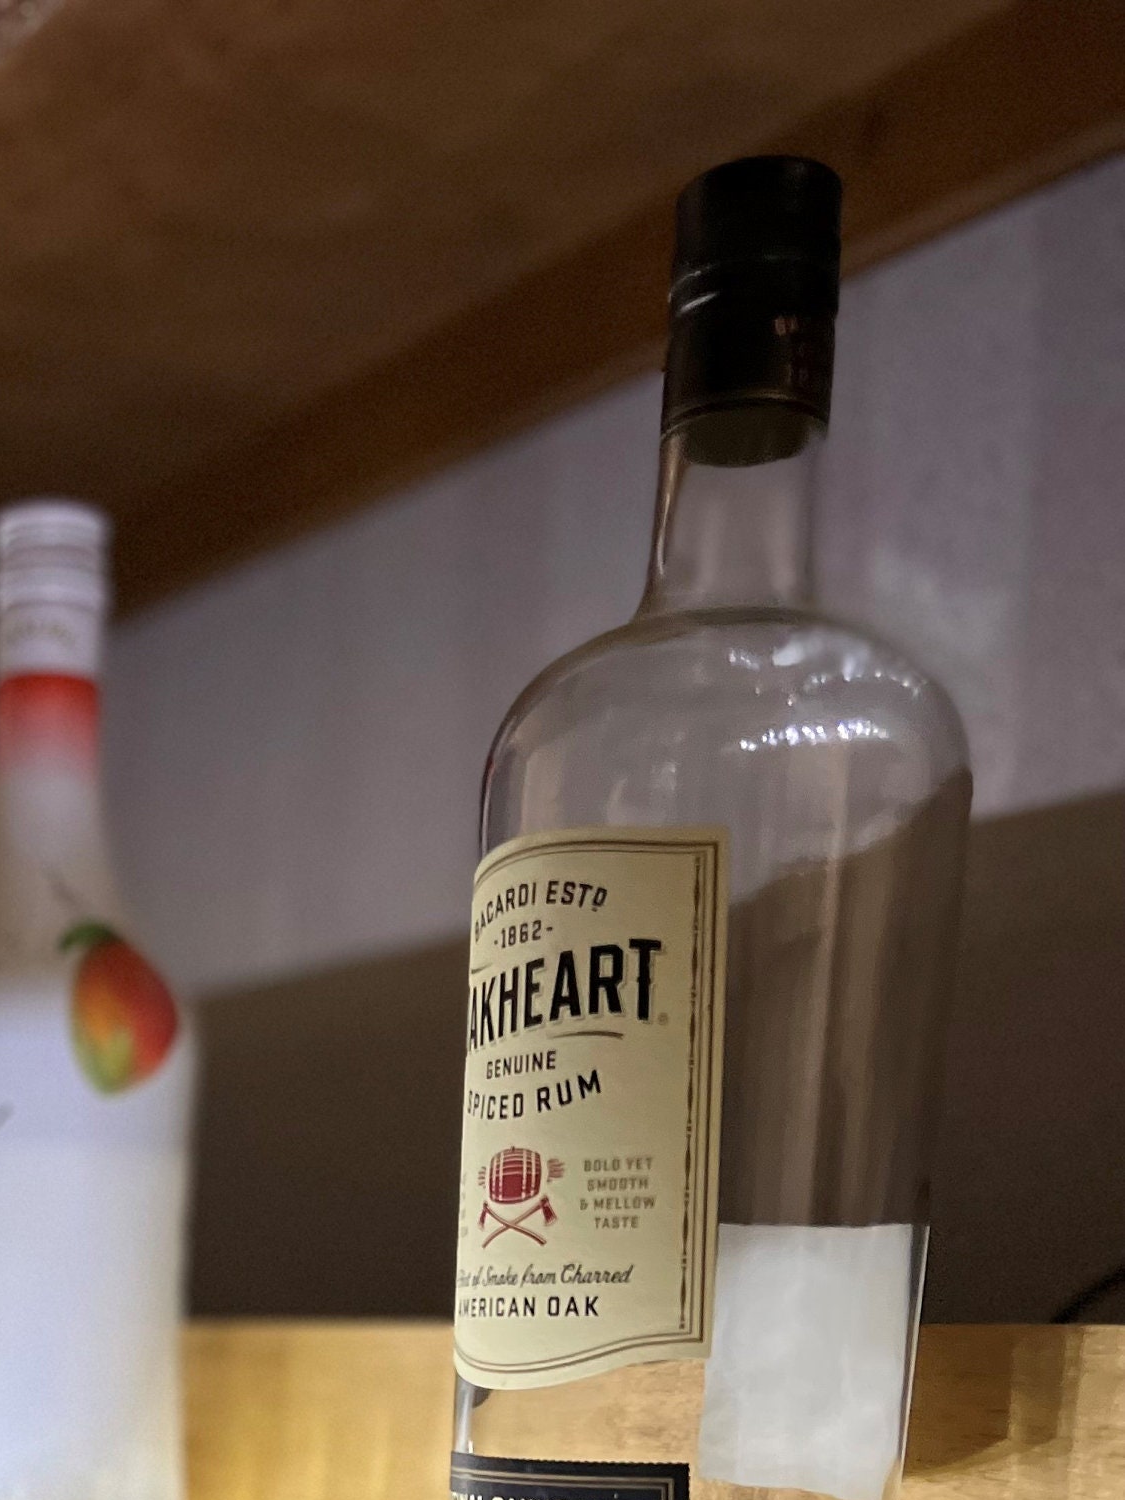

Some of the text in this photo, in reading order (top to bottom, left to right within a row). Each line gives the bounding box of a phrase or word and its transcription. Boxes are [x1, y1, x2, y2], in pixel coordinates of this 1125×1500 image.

[486, 1050, 557, 1080] GENUINE
[467, 1069, 602, 1120] SPICED RUM
[583, 1157, 653, 1172] BOLD YET
[587, 1177, 649, 1192] SMOOTH
[593, 1196, 655, 1211] MELLOW
[594, 1215, 639, 1230] TASTE
[519, 1263, 557, 1288] from
[560, 1262, 635, 1287] Charred
[547, 1295, 600, 1318] OAK
